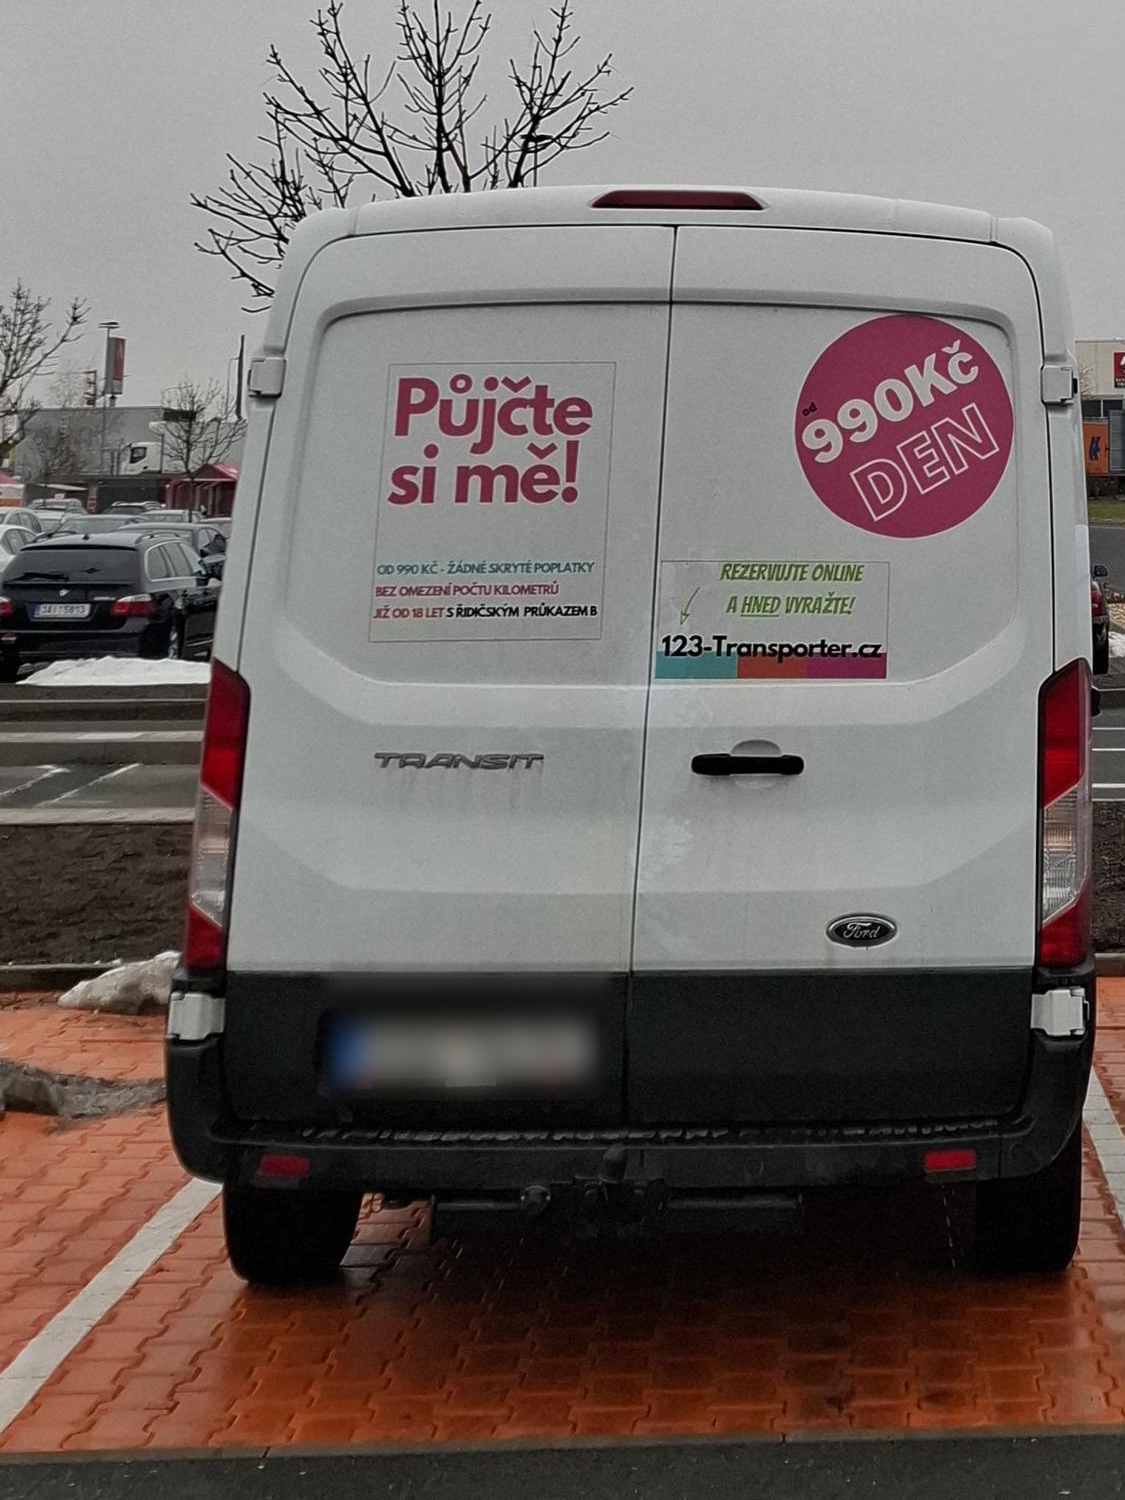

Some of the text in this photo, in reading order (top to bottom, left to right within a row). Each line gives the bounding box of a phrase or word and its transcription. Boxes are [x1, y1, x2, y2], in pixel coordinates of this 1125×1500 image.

[802, 339, 979, 463] 990Kč
[802, 402, 817, 417] od
[394, 373, 593, 455] Půjčte
[849, 402, 1000, 522] DEN
[387, 440, 580, 506] si mě!
[377, 564, 394, 576] OD
[396, 564, 419, 576] 990
[421, 560, 438, 575] KČ
[447, 560, 487, 575] ŽÁDNÉ
[489, 559, 532, 574] SKRYTÉ
[534, 561, 595, 574] POPLATKY
[720, 563, 865, 582] REZERVUJTE ONLINE
[375, 580, 559, 597] BEZ OMEZENÍ POČTU KILOMETRŮ
[373, 602, 598, 619] JIŽ OD 18 LET S ŘIDIČSKÝM PRŮKAZEM B
[726, 591, 856, 615] A HNED VYRAŽTE!
[661, 634, 883, 663] 123-Transporter.cz
[374, 752, 544, 770] TRANSIT
